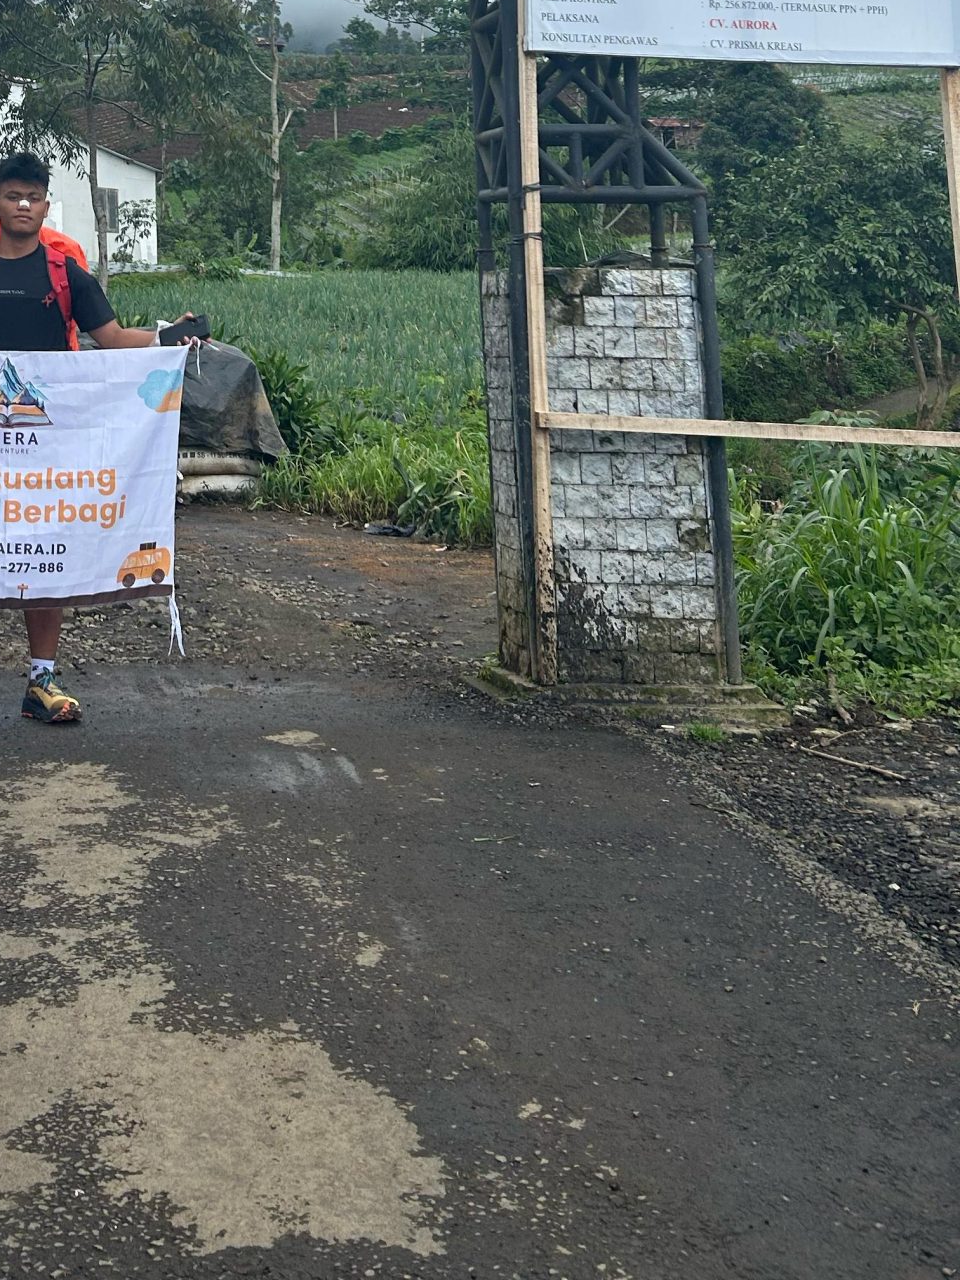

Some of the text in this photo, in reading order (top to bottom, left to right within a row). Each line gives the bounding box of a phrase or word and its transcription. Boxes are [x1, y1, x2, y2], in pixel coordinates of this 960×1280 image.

[781, 2, 836, 13] (TERMASUK
[839, 4, 857, 14] PPN
[867, 5, 888, 16] PPH)
[541, 12, 599, 23] PELAKSANA
[730, 19, 778, 31] AURORA
[541, 31, 602, 43] KONSULTAN
[603, 34, 658, 46] PENGAWAS
[728, 40, 765, 51] PRISMA
[767, 41, 803, 52] KREASI
[3, 494, 127, 529] Berbagi
